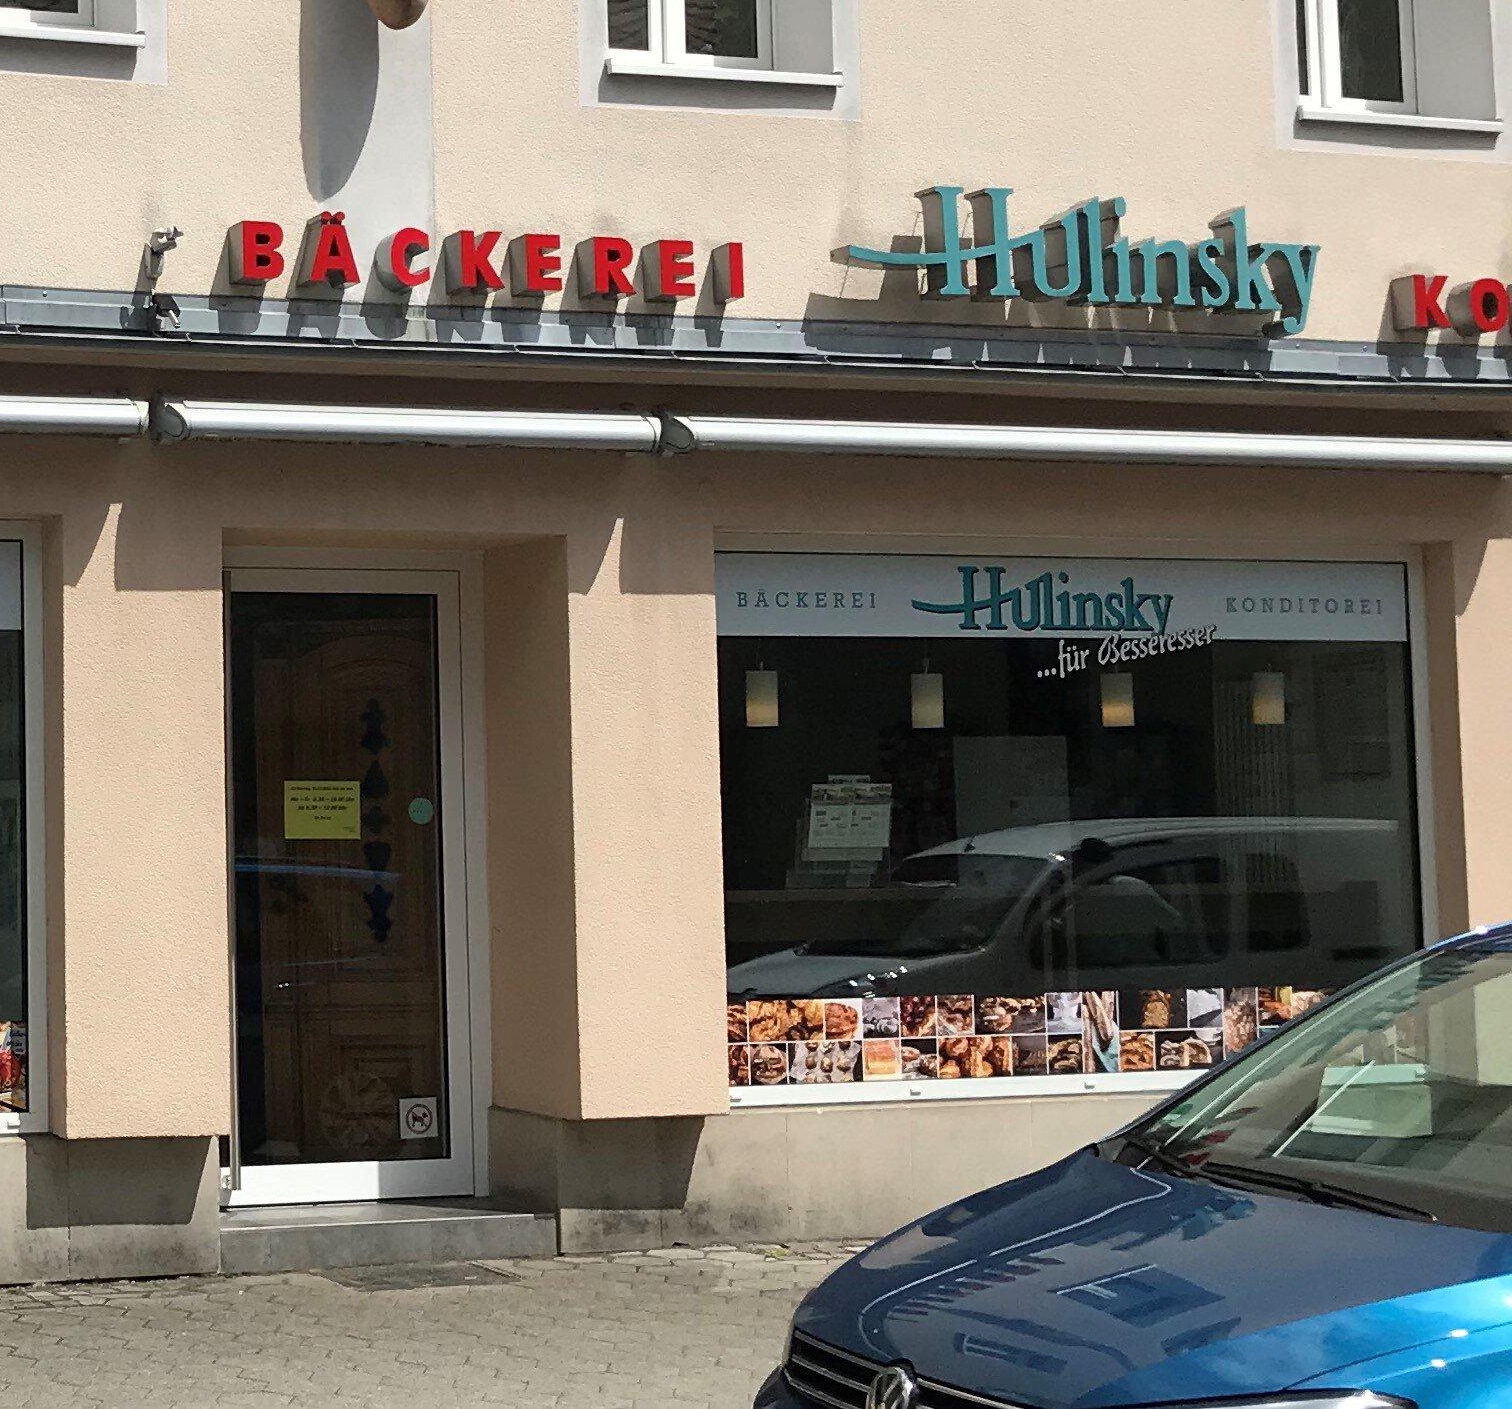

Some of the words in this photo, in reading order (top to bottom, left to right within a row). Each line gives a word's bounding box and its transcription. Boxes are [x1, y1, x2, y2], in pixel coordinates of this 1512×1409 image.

[239, 211, 744, 299] BÄCKEREI
[840, 185, 1320, 334] Hulinsky
[1412, 275, 1512, 334] KO
[736, 587, 877, 609] BÄCKEREI
[911, 565, 1174, 634] Hulinsky
[1225, 596, 1384, 616] KONDITOREI
[1098, 623, 1218, 666] Besseresser
